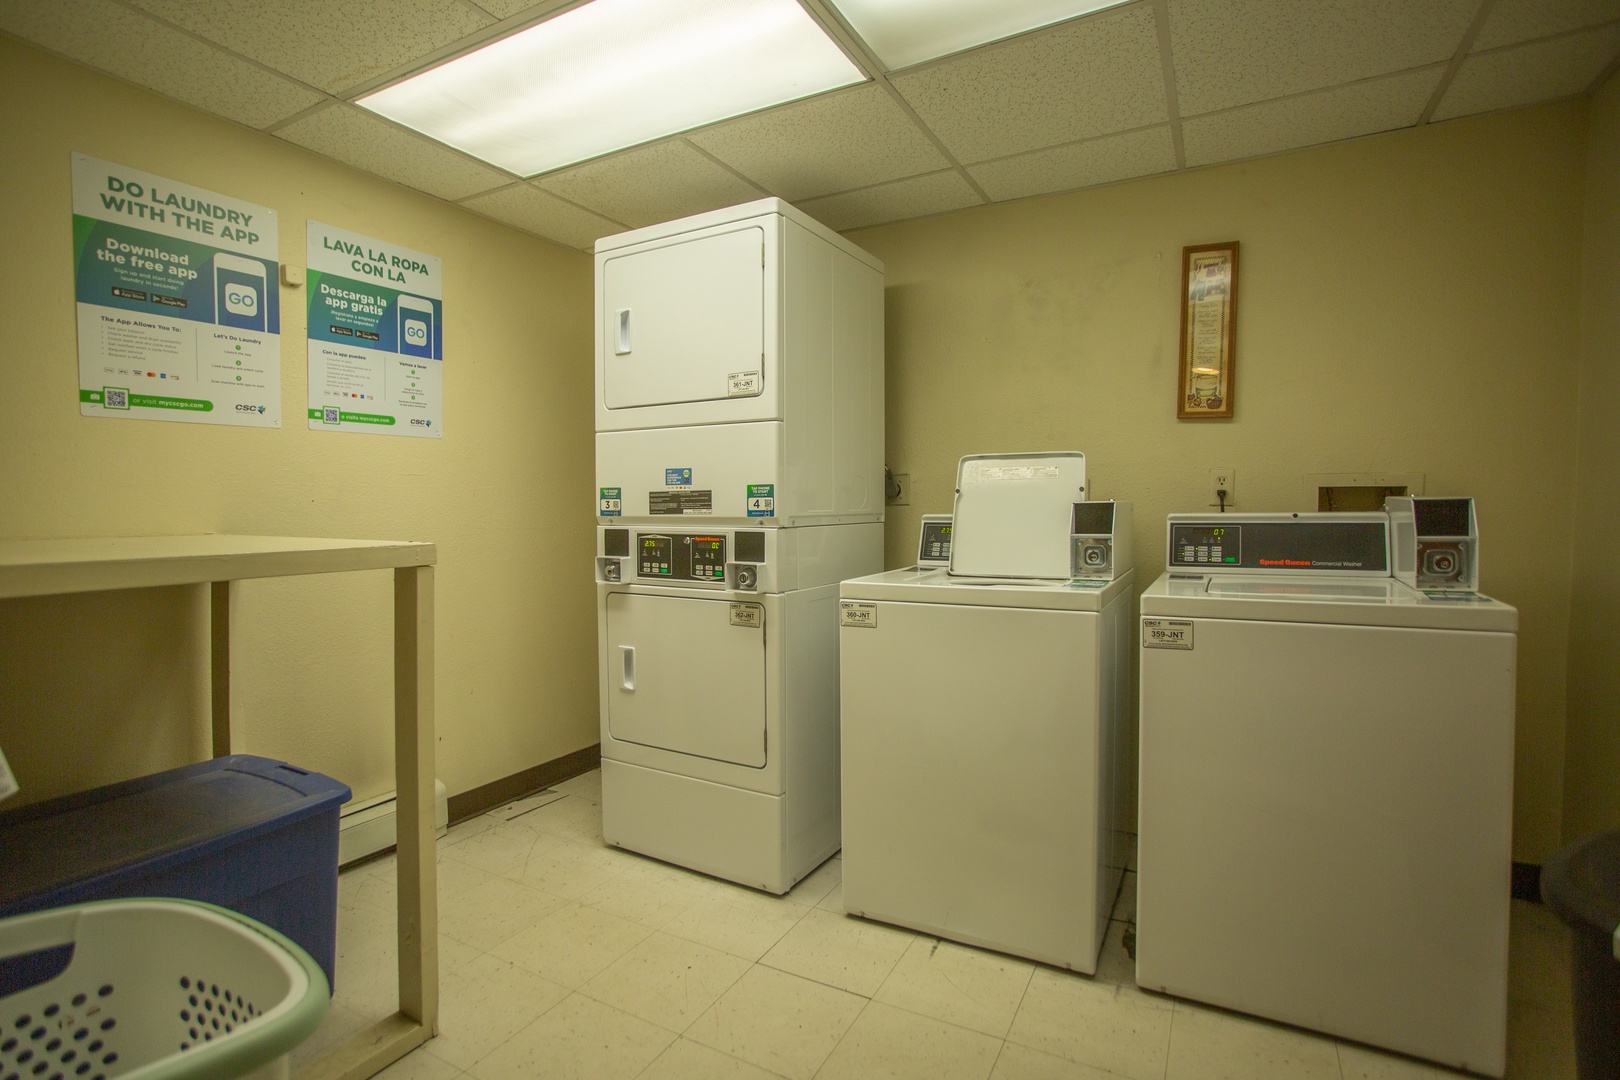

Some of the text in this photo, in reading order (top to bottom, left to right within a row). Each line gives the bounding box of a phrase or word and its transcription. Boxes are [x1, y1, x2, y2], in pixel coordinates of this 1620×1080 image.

[107, 176, 253, 227] DO LAUNDRY
[100, 192, 259, 245] WITH THE APP
[106, 238, 189, 266] Download
[324, 236, 428, 276] LAVA LA ROPA
[97, 249, 198, 280] the free app
[352, 260, 406, 284] CON LA
[121, 276, 144, 284] laundry
[153, 282, 178, 290] seconds!
[229, 292, 254, 307] GO
[321, 284, 387, 307] Descarga la
[326, 297, 383, 316] app gratis
[239, 337, 261, 345] Laundry
[407, 327, 424, 338] GO
[158, 400, 203, 409] mycscgo.com
[605, 501, 610, 509] 3
[753, 499, 760, 508] 4
